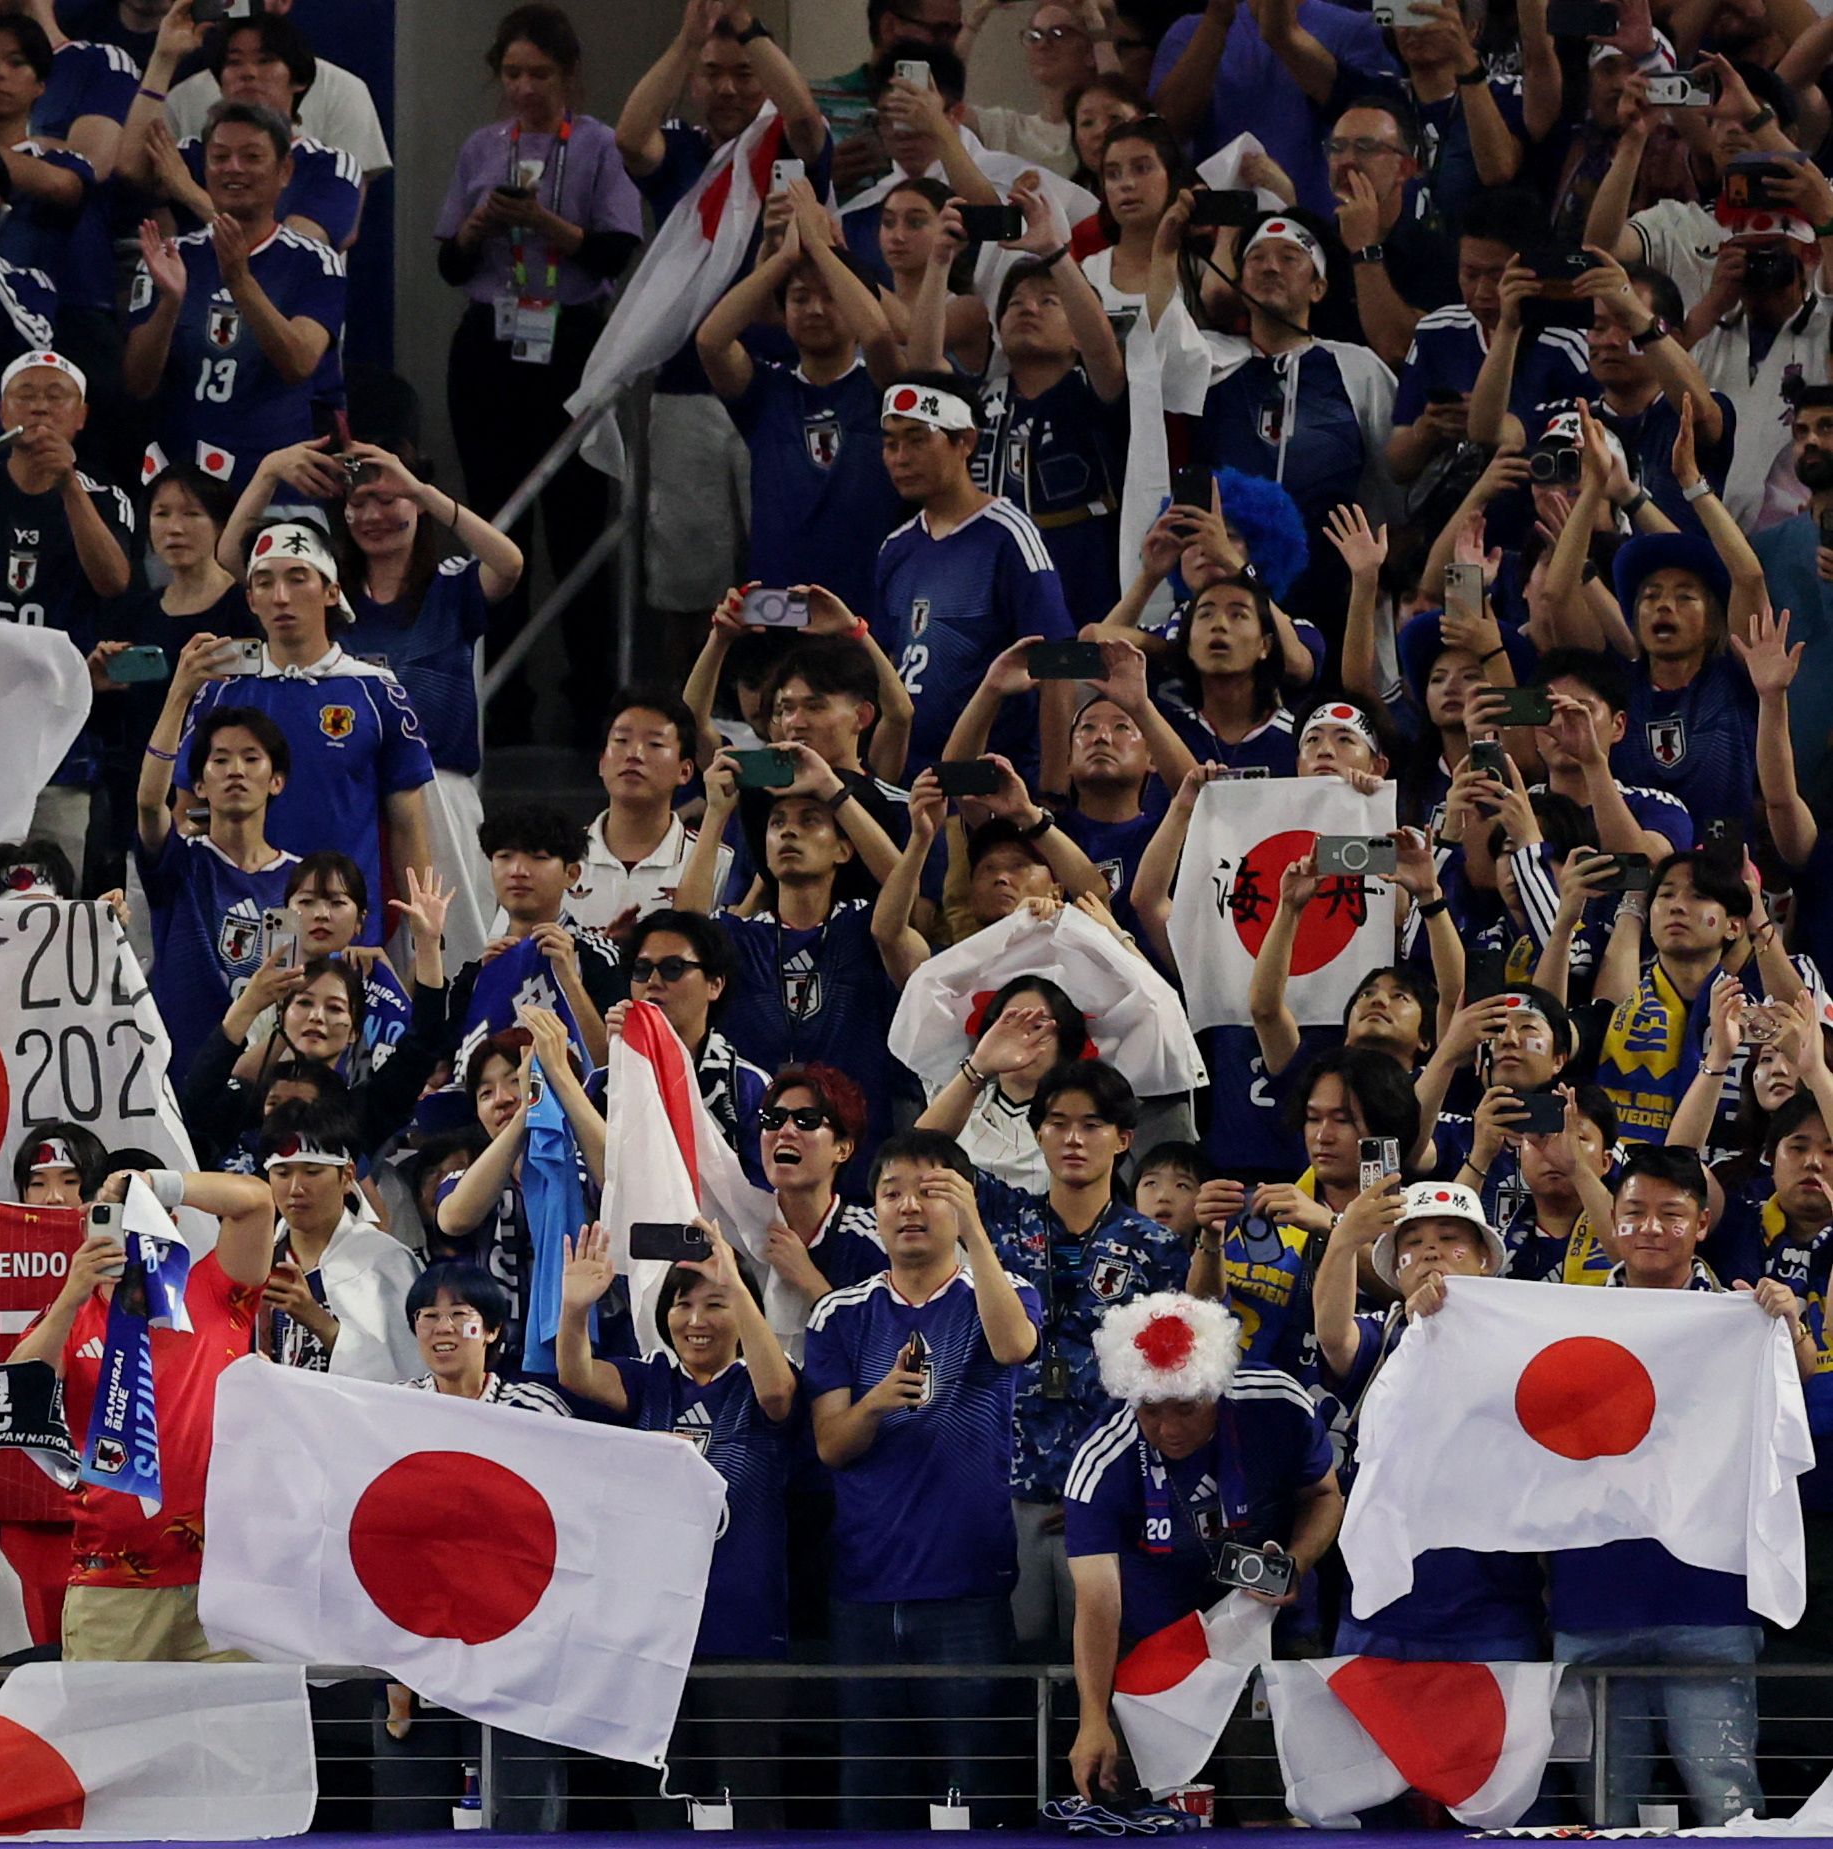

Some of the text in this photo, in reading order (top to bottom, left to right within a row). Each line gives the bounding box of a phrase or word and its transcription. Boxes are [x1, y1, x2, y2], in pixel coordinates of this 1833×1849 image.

[194, 358, 239, 402] 13
[14, 530, 39, 544] Y-3
[281, 531, 310, 555] 本
[18, 902, 149, 1010] 202
[16, 1020, 161, 1128] 202
[104, 1349, 125, 1429] SAMURAI
[113, 1387, 129, 1432] BLUE
[27, 1433, 71, 1449] NATION
[1146, 1517, 1172, 1541] 20
